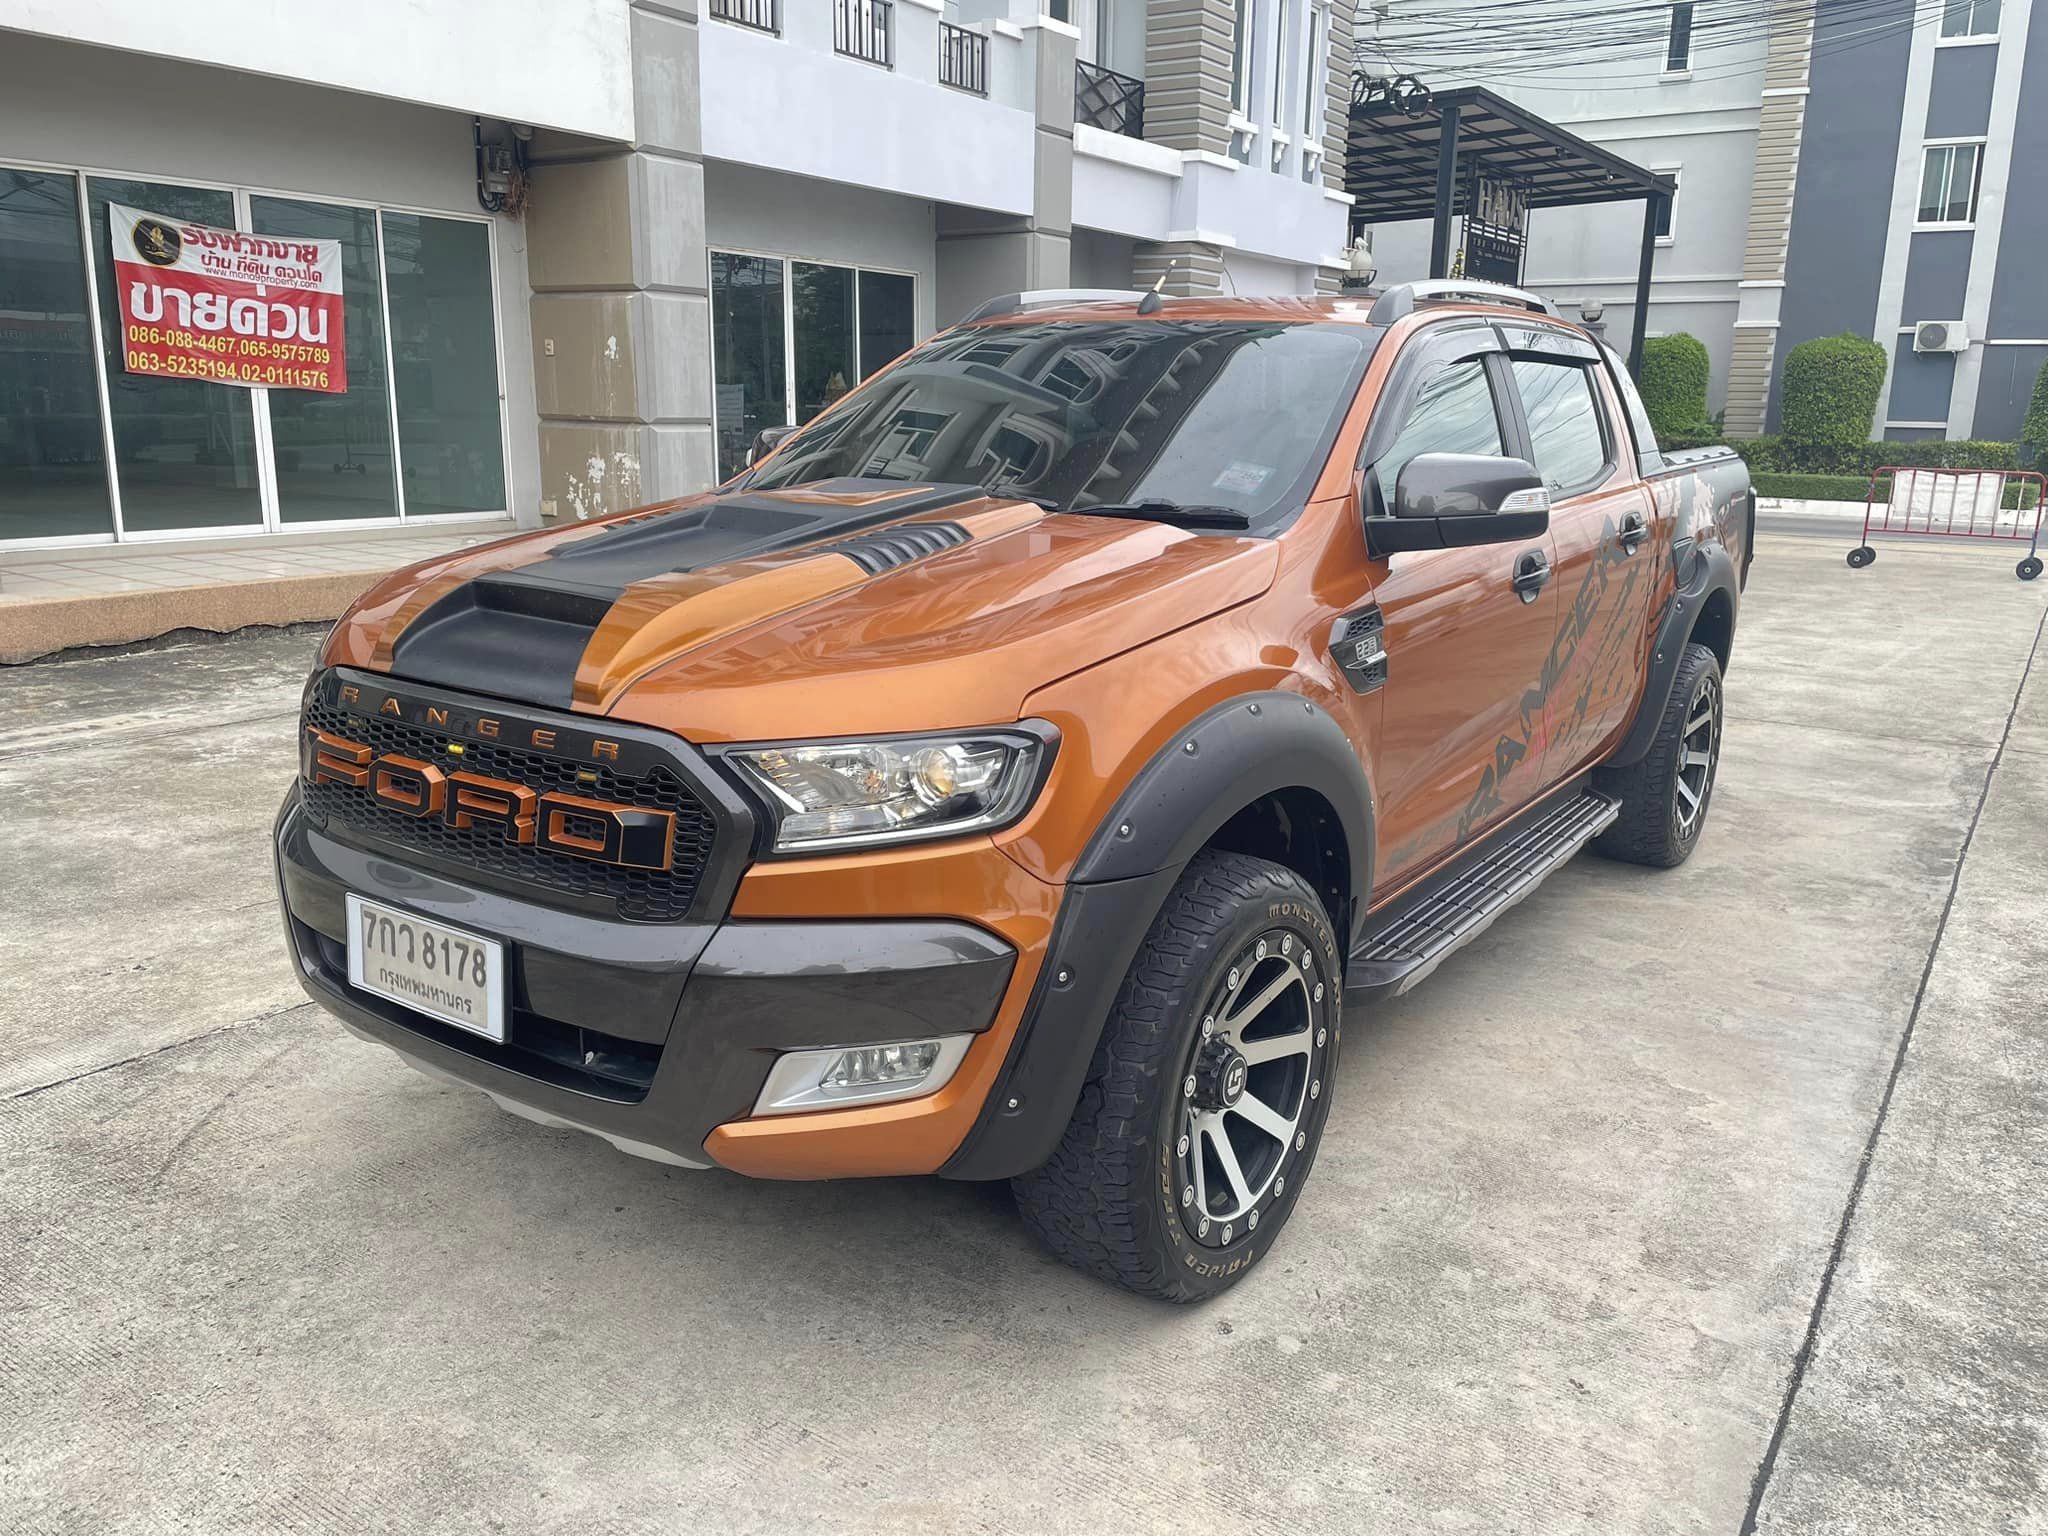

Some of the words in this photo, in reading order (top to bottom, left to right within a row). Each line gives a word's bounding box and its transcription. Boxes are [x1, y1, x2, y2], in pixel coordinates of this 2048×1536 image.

[201, 250, 231, 270] บ้าน
[130, 282, 329, 344] ขายด่วน
[340, 685, 622, 761] RANGER
[306, 726, 678, 872] FORD
[363, 910, 415, 964] 7กว
[422, 931, 488, 989] 8178
[1268, 902, 1334, 960] MONSTER
[379, 967, 473, 1014] กรุงเทพมหานคร
